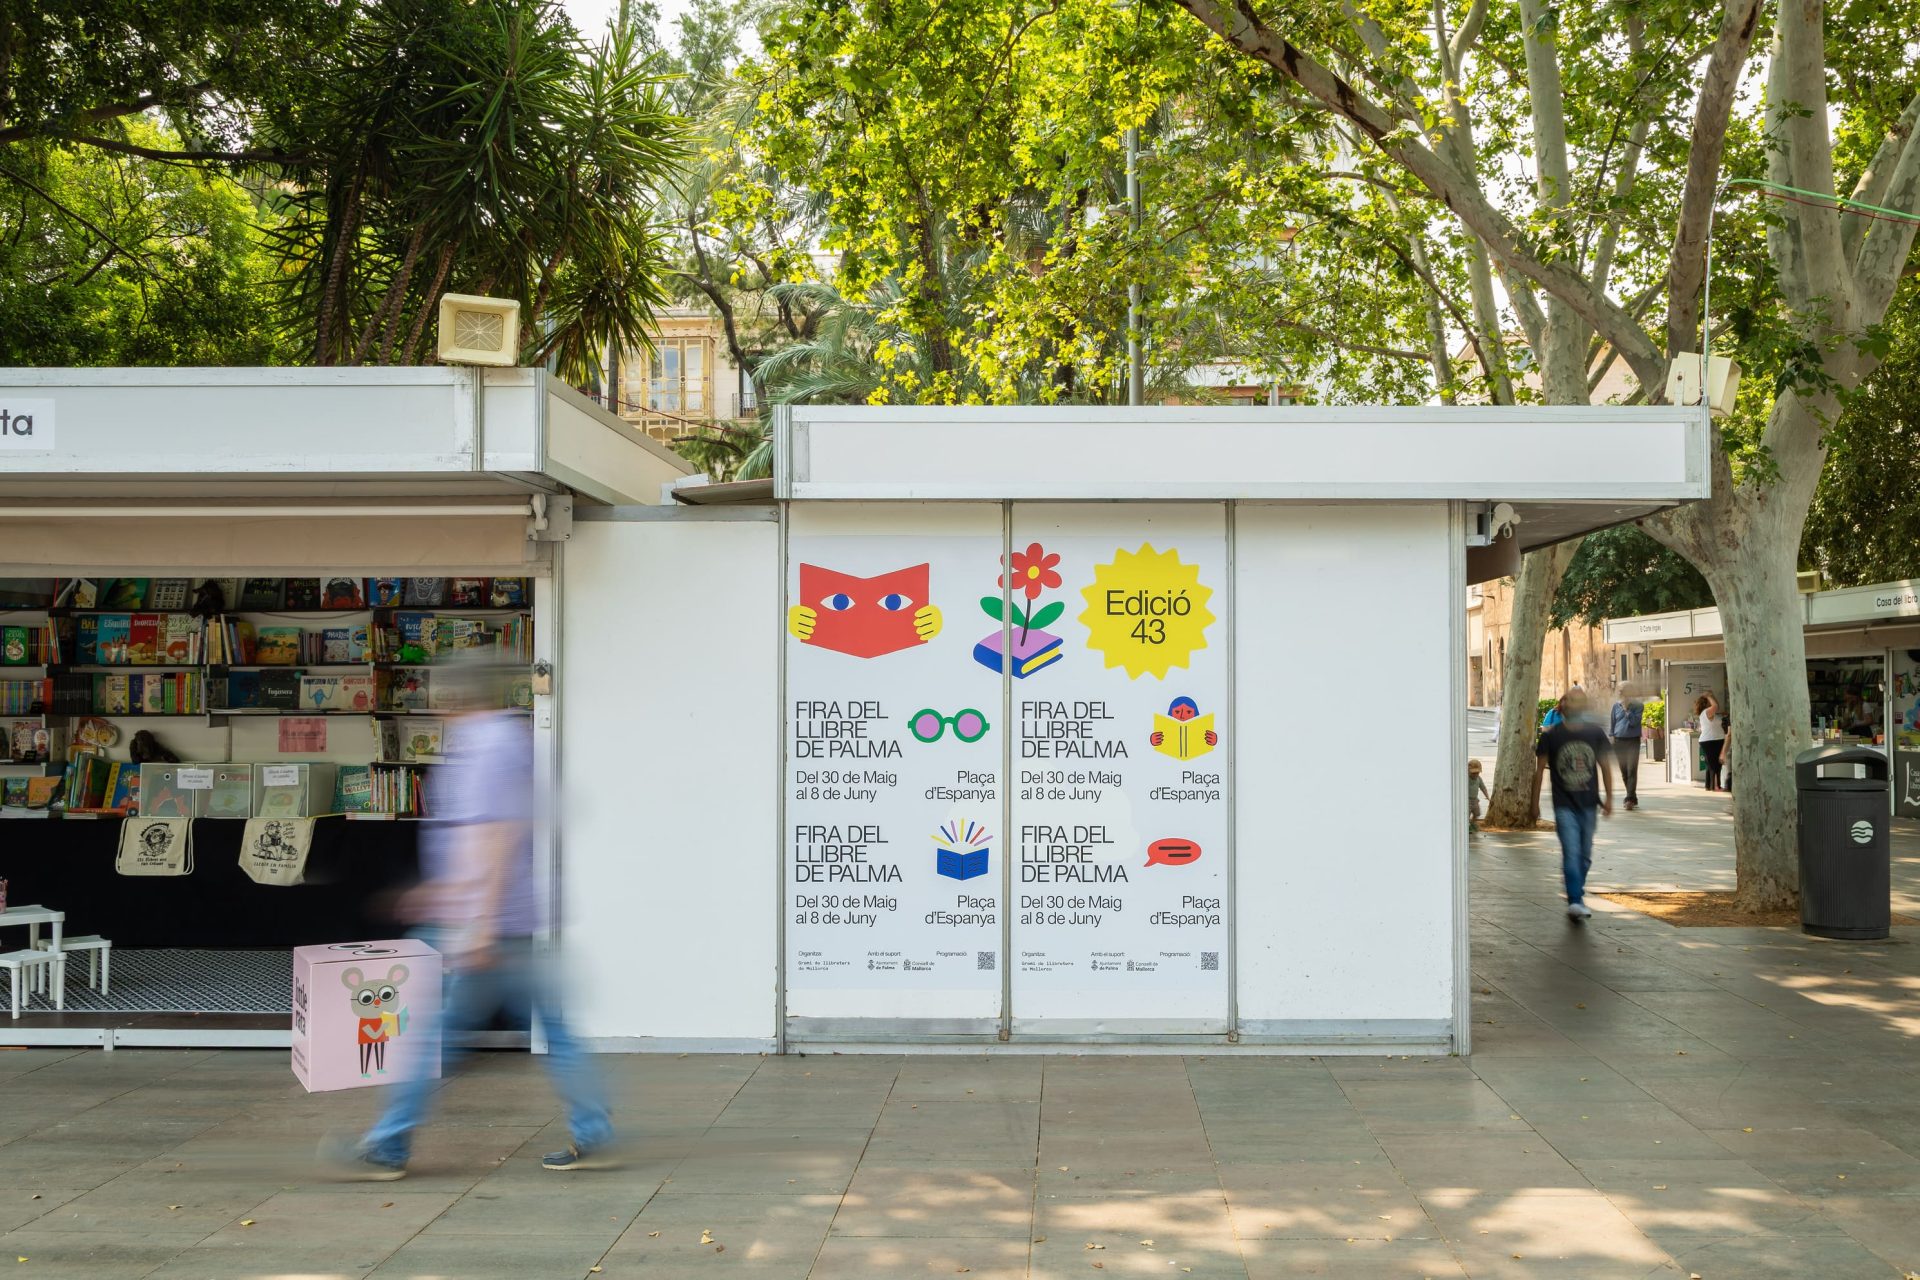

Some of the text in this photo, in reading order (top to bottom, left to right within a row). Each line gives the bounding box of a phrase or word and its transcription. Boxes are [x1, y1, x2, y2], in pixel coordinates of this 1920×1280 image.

[1107, 589, 1190, 616] Edició
[1876, 597, 1892, 608] Casa
[1893, 595, 1903, 606] del
[1131, 618, 1165, 645] 43
[796, 701, 888, 719] FIRA DEL
[1022, 701, 1114, 719] FIRA DEL
[796, 720, 867, 739] LLIBRE
[1022, 720, 1093, 739] LLIBRE
[796, 740, 902, 758] DE PALMA
[1022, 740, 1128, 758] DE PALMA
[796, 770, 897, 787] Del 30 de Maig
[958, 770, 996, 788] Plaça
[1021, 770, 1122, 787] Del 30 de Maig
[1183, 770, 1221, 788] Plaça
[796, 787, 877, 804] al 8 de Juny
[925, 787, 996, 803] d'Espanya
[1021, 787, 1102, 804] al 8 de Juny
[1150, 787, 1221, 803] d'Espanya
[796, 826, 888, 844] FIRA DEL
[1022, 826, 1114, 844] FIRA DEL
[796, 845, 867, 864] LLIBRE
[1022, 845, 1093, 864] LLIBRE
[796, 865, 902, 883] DE PALMA
[1022, 865, 1128, 883] DE PALMA
[796, 895, 897, 912] Del 30 de Maig
[958, 895, 996, 913] Plaça
[1021, 895, 1122, 912] Del 30 de Maig
[1183, 895, 1221, 913] Plaça
[796, 912, 877, 929] al 8 de Juny
[925, 912, 996, 928] d'Espanya
[1021, 912, 1102, 929] al 8 de Juny
[1150, 912, 1221, 928] d'Espanya
